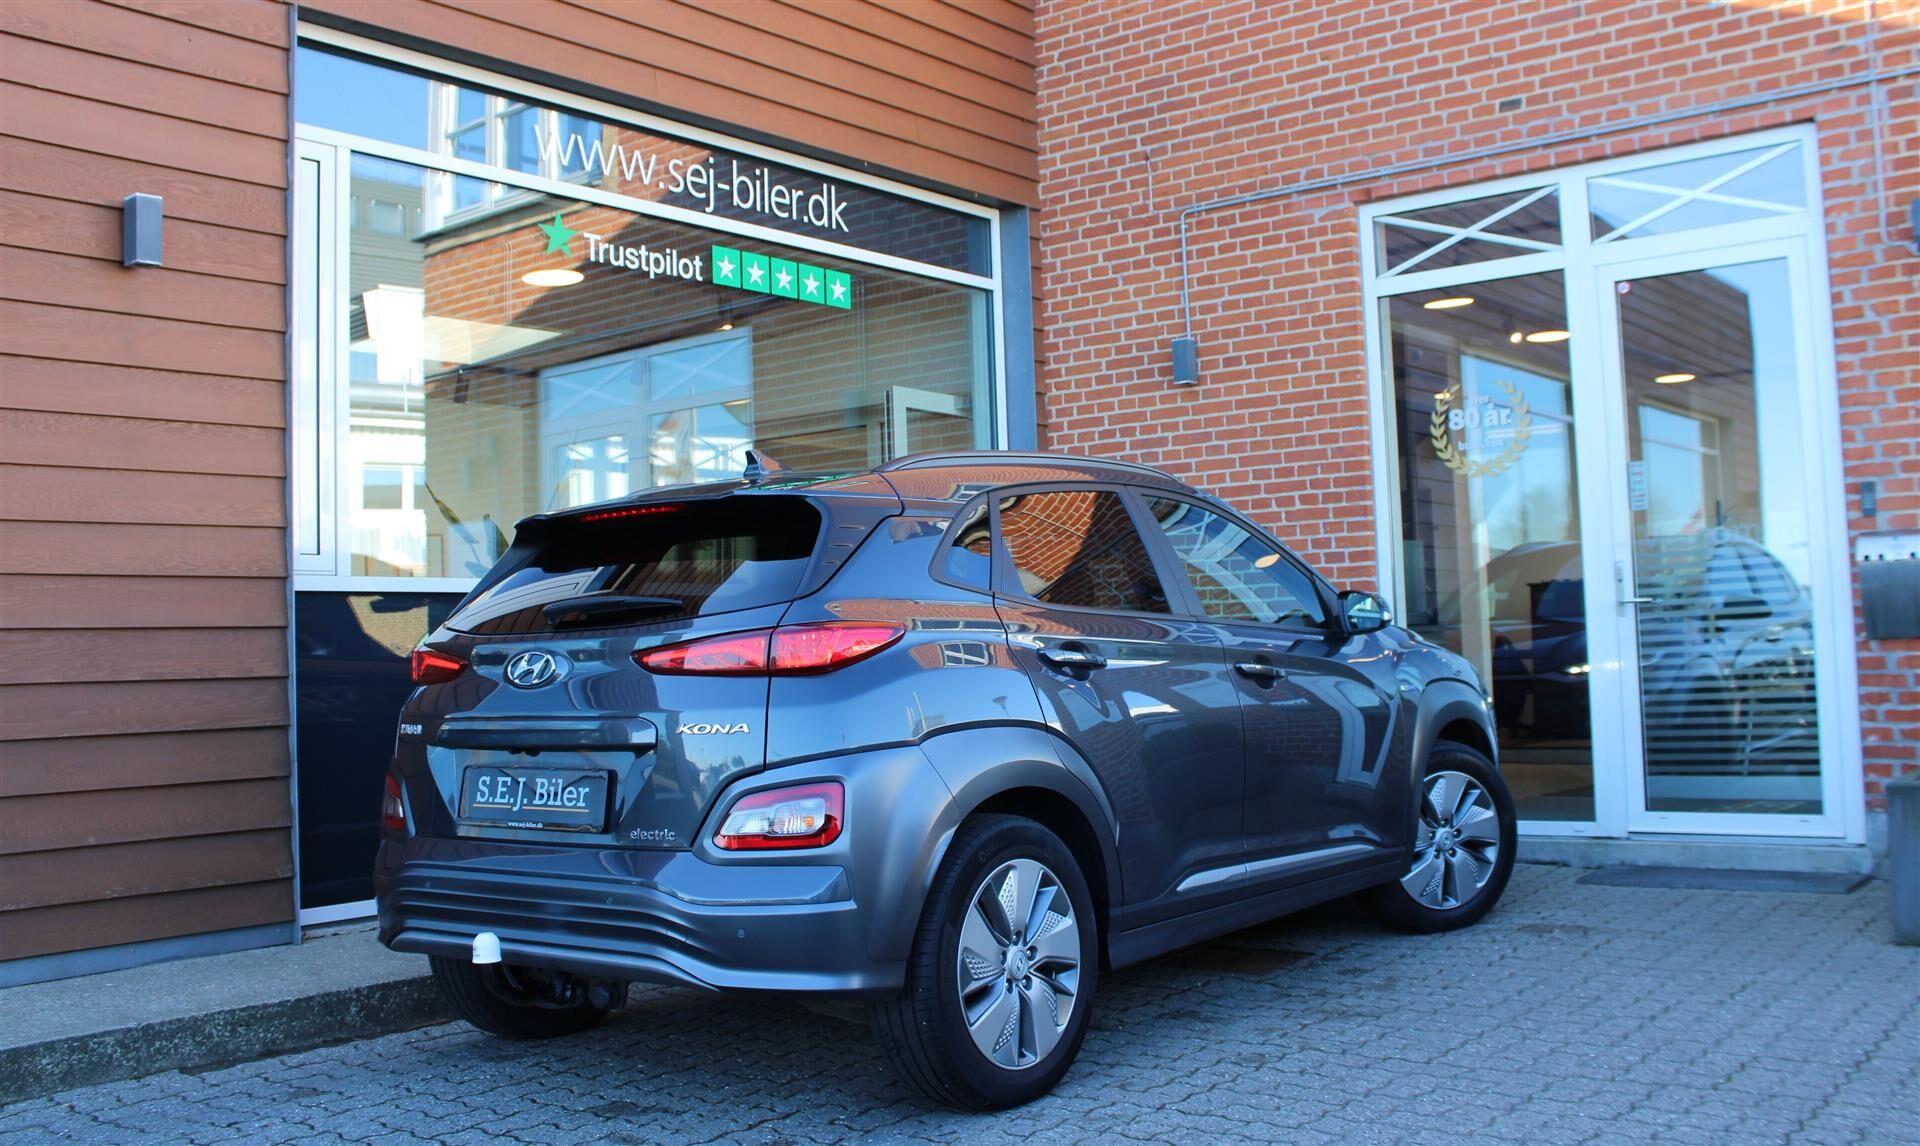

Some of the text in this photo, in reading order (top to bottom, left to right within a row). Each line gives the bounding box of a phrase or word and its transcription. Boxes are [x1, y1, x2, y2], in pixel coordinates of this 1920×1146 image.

[534, 124, 849, 232] www.sej-biler.dk
[583, 232, 703, 282] Trustpilot
[1448, 408, 1480, 431] 80
[676, 723, 750, 734] KONA
[476, 775, 590, 811] S.E.J. Biler
[630, 828, 676, 841] electric
